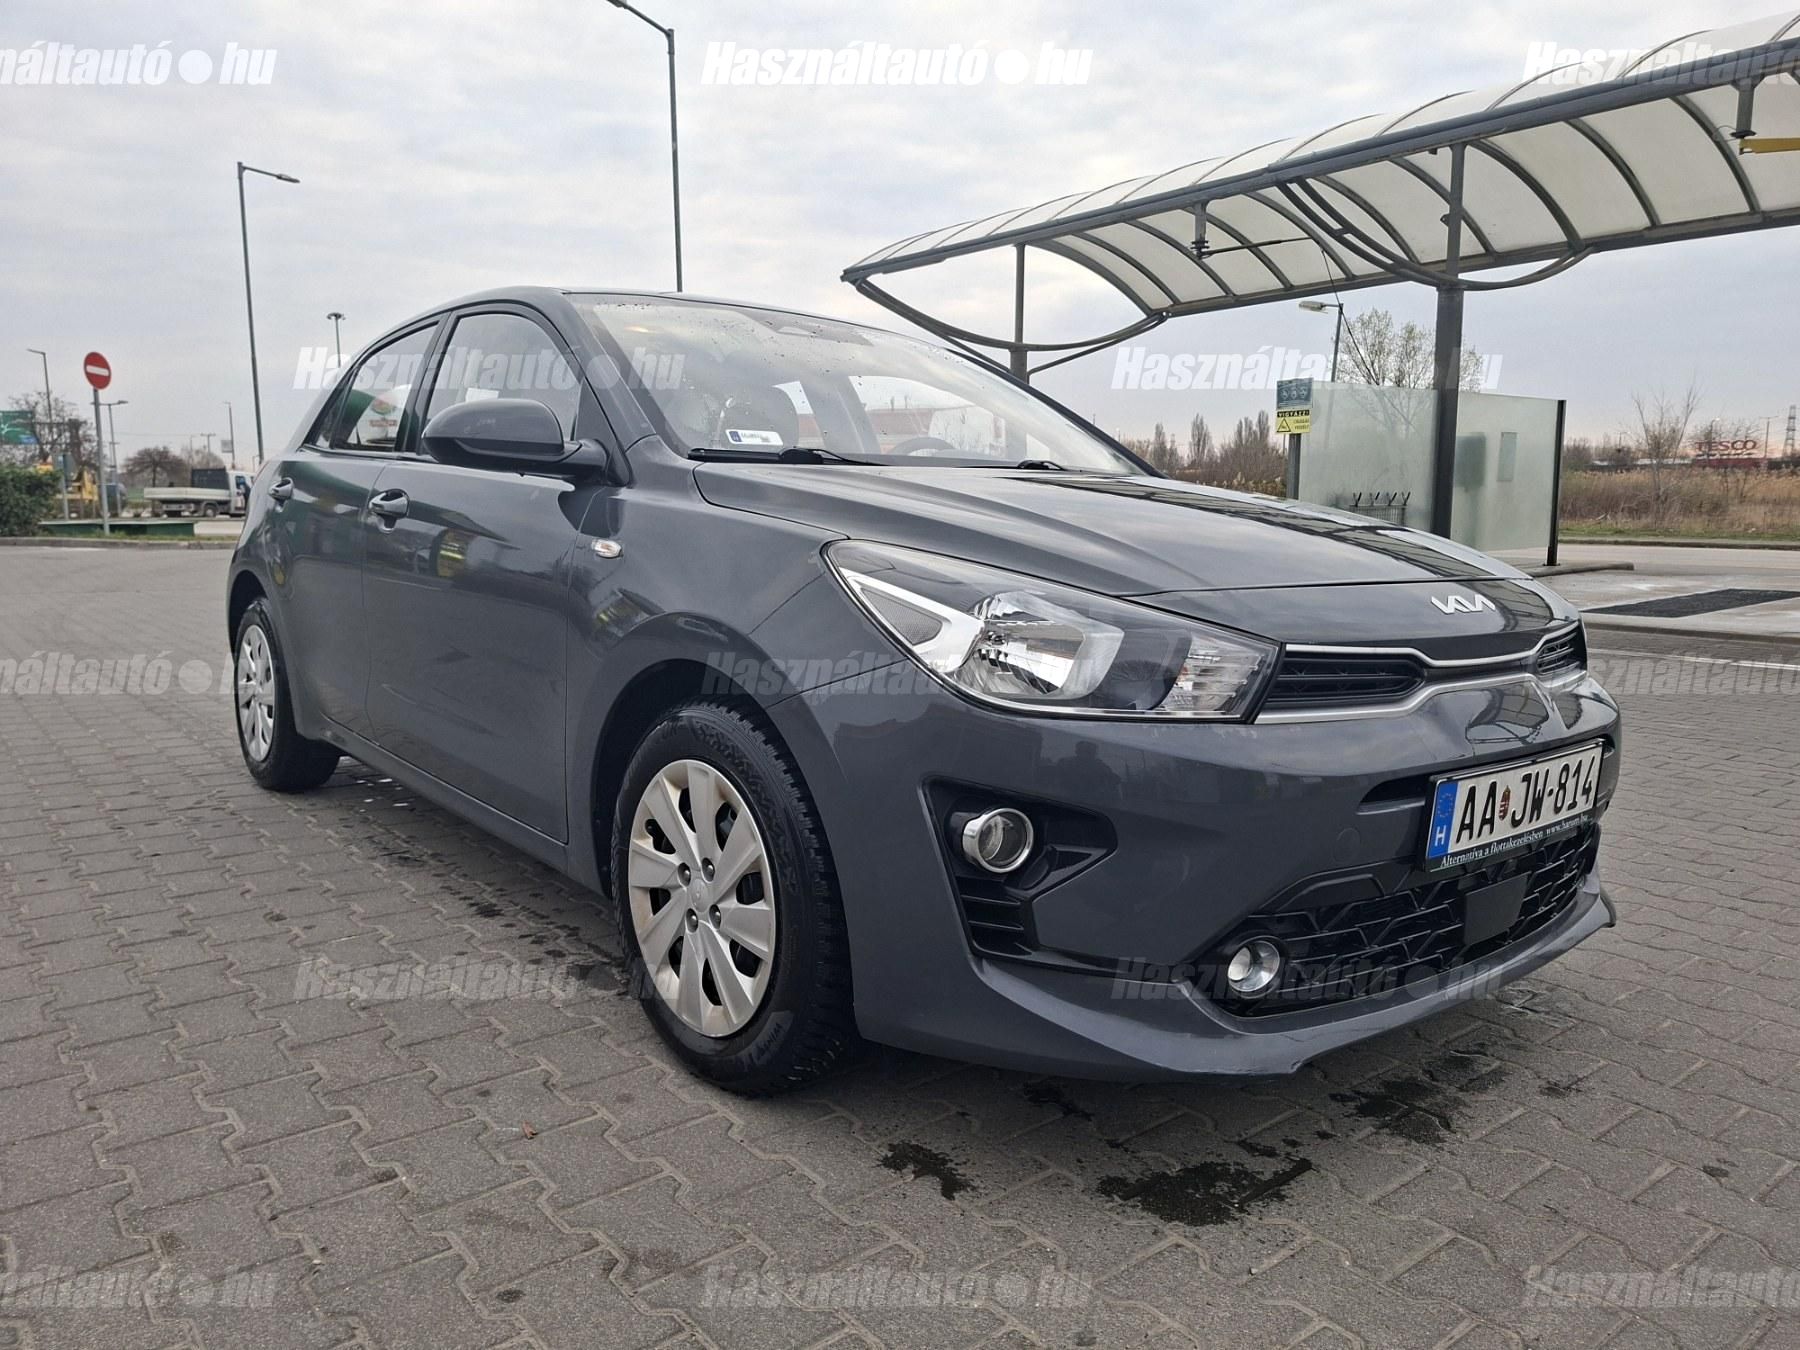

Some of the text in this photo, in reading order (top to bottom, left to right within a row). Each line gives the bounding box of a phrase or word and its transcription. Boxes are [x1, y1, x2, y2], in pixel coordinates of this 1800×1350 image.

[1695, 440, 1757, 452] TESCO
[1431, 594, 1496, 614] KIA
[1455, 755, 1596, 844] AA JW-814
[1434, 824, 1447, 847] H
